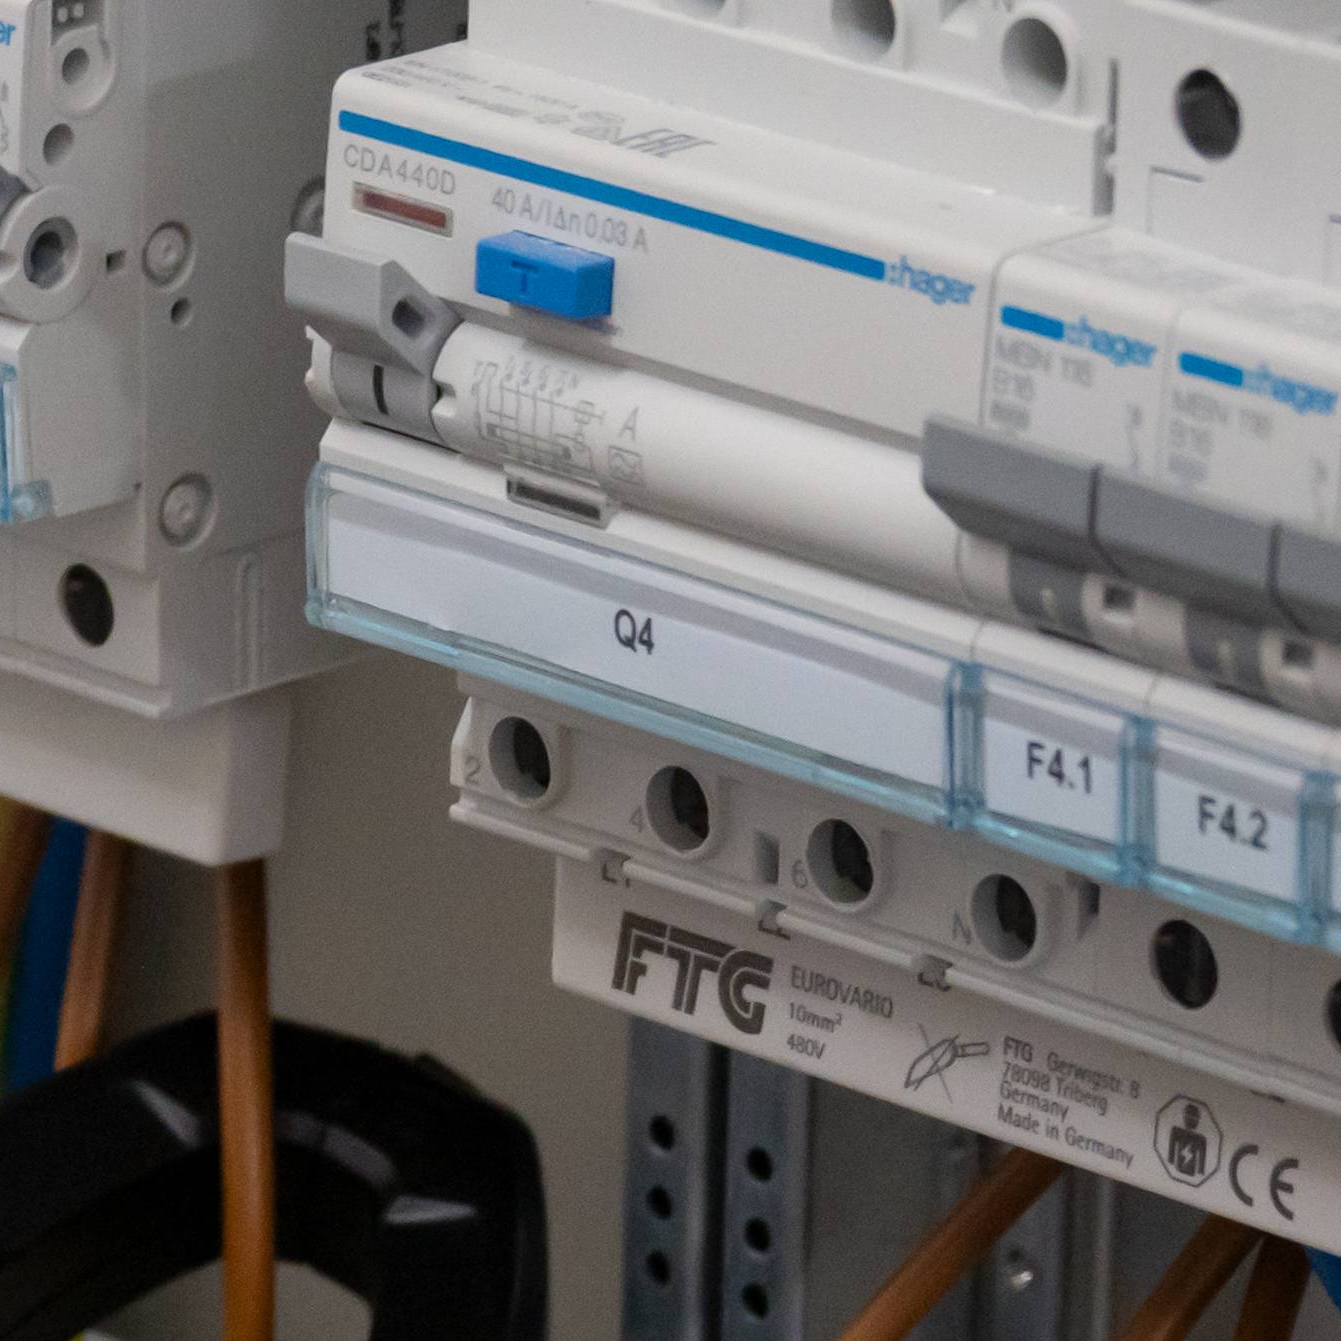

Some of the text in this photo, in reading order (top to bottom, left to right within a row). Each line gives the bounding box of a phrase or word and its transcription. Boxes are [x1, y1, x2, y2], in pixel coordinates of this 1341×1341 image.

[344, 144, 457, 195] CDA440D
[492, 188, 516, 215] 40
[614, 608, 655, 656] Q4
[1026, 741, 1094, 795] F4.1
[1195, 794, 1269, 852] F4.2
[790, 964, 894, 1020] EUROVARIO
[999, 1081, 1069, 1123] Germany
[1055, 1077, 1109, 1117] Triberg
[997, 1103, 1135, 1170] Made in Germany
[1228, 1143, 1300, 1221] CE
